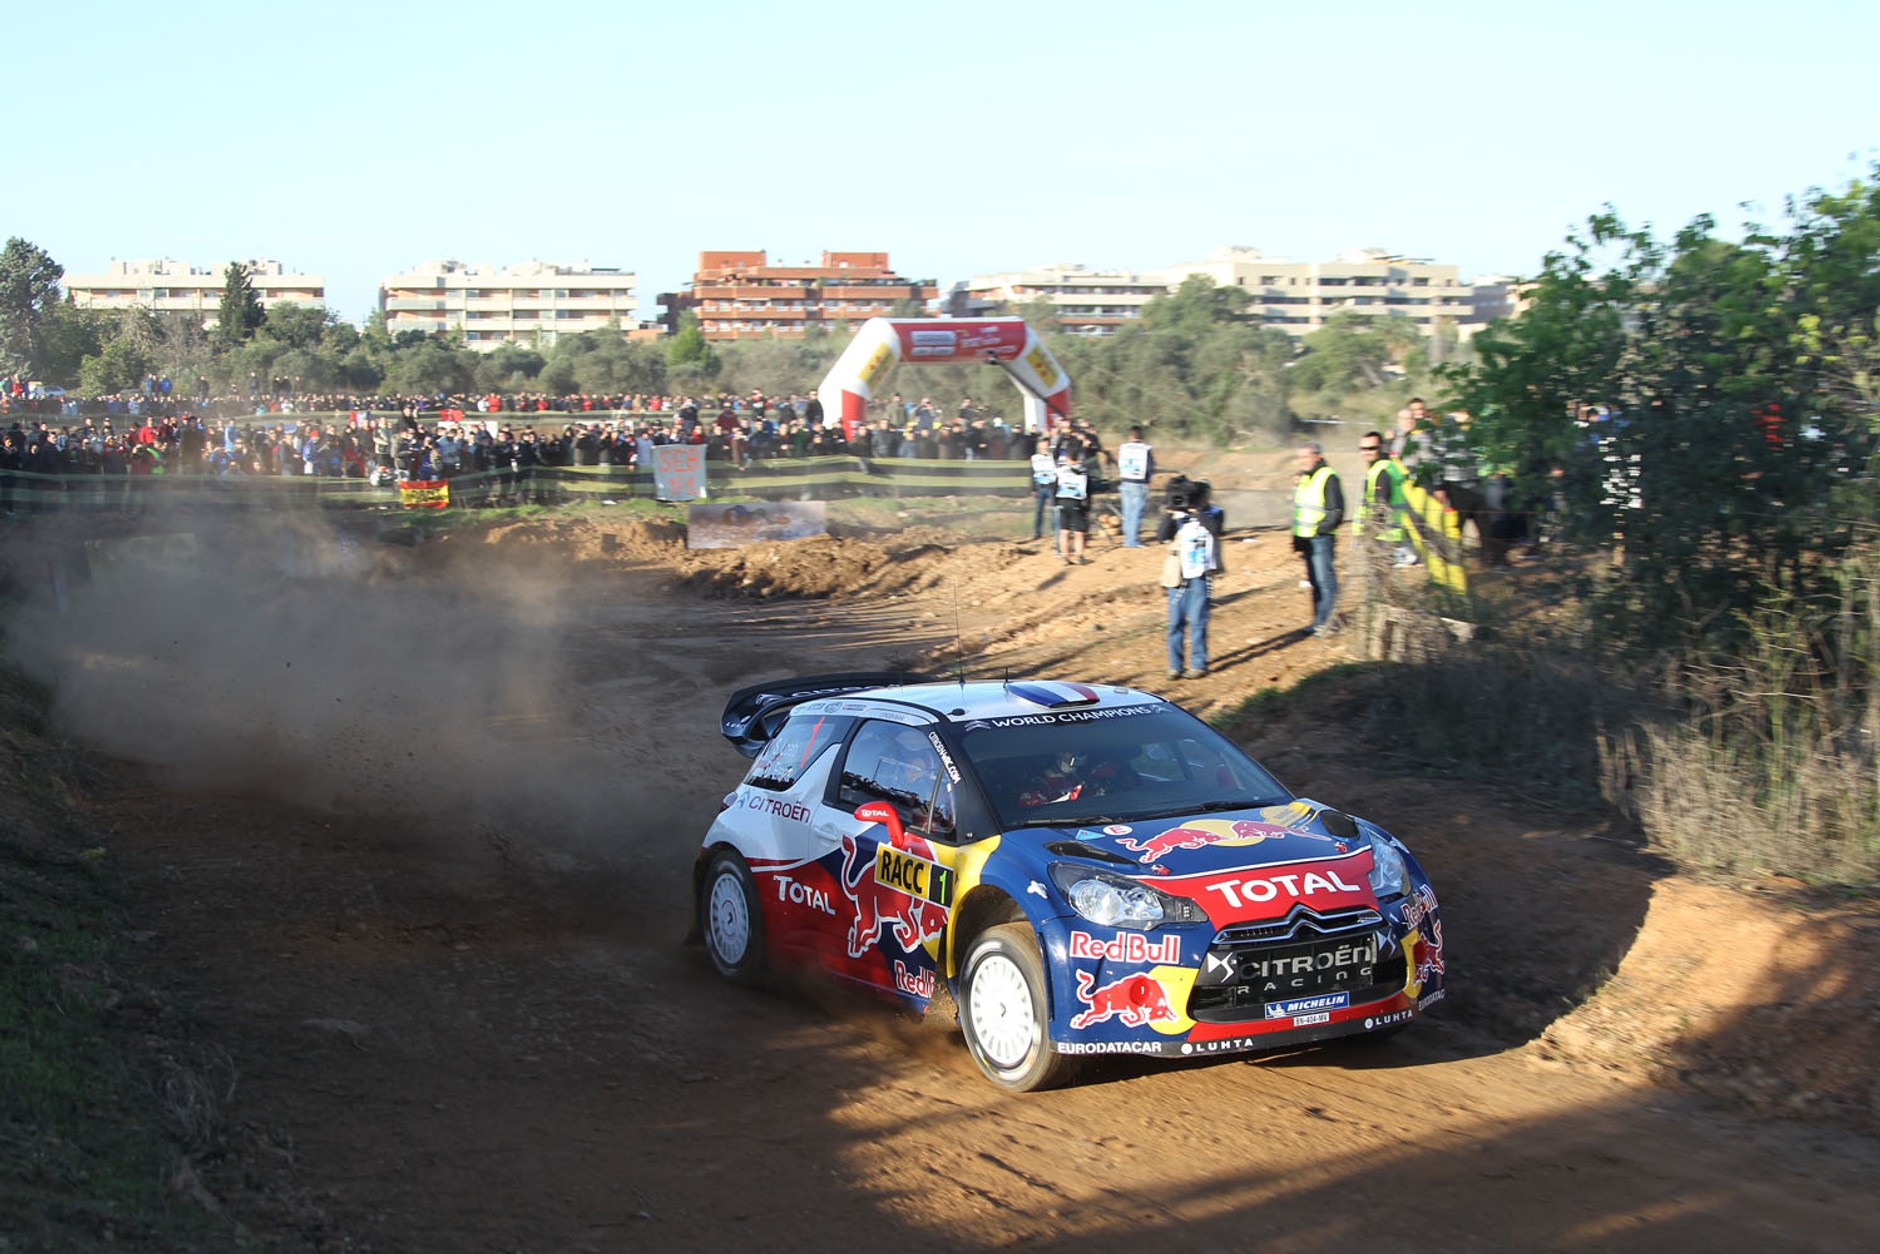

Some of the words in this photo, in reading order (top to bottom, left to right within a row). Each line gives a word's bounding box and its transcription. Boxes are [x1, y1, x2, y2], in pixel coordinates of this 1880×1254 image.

[992, 711, 1055, 728] WORLD
[1059, 705, 1151, 723] CHAMPIONS
[861, 808, 890, 817] TOTAL
[881, 850, 925, 894] RACC
[938, 870, 948, 904] 1
[773, 875, 837, 916] TOTAL
[1205, 870, 1361, 908] TOTAL
[1237, 966, 1372, 995] RACING
[1287, 995, 1345, 1013] MICHELIN
[1375, 1009, 1414, 1025] LUHTA
[1057, 1041, 1162, 1054] EURODATACAR
[1196, 1038, 1254, 1052] LUHTA
